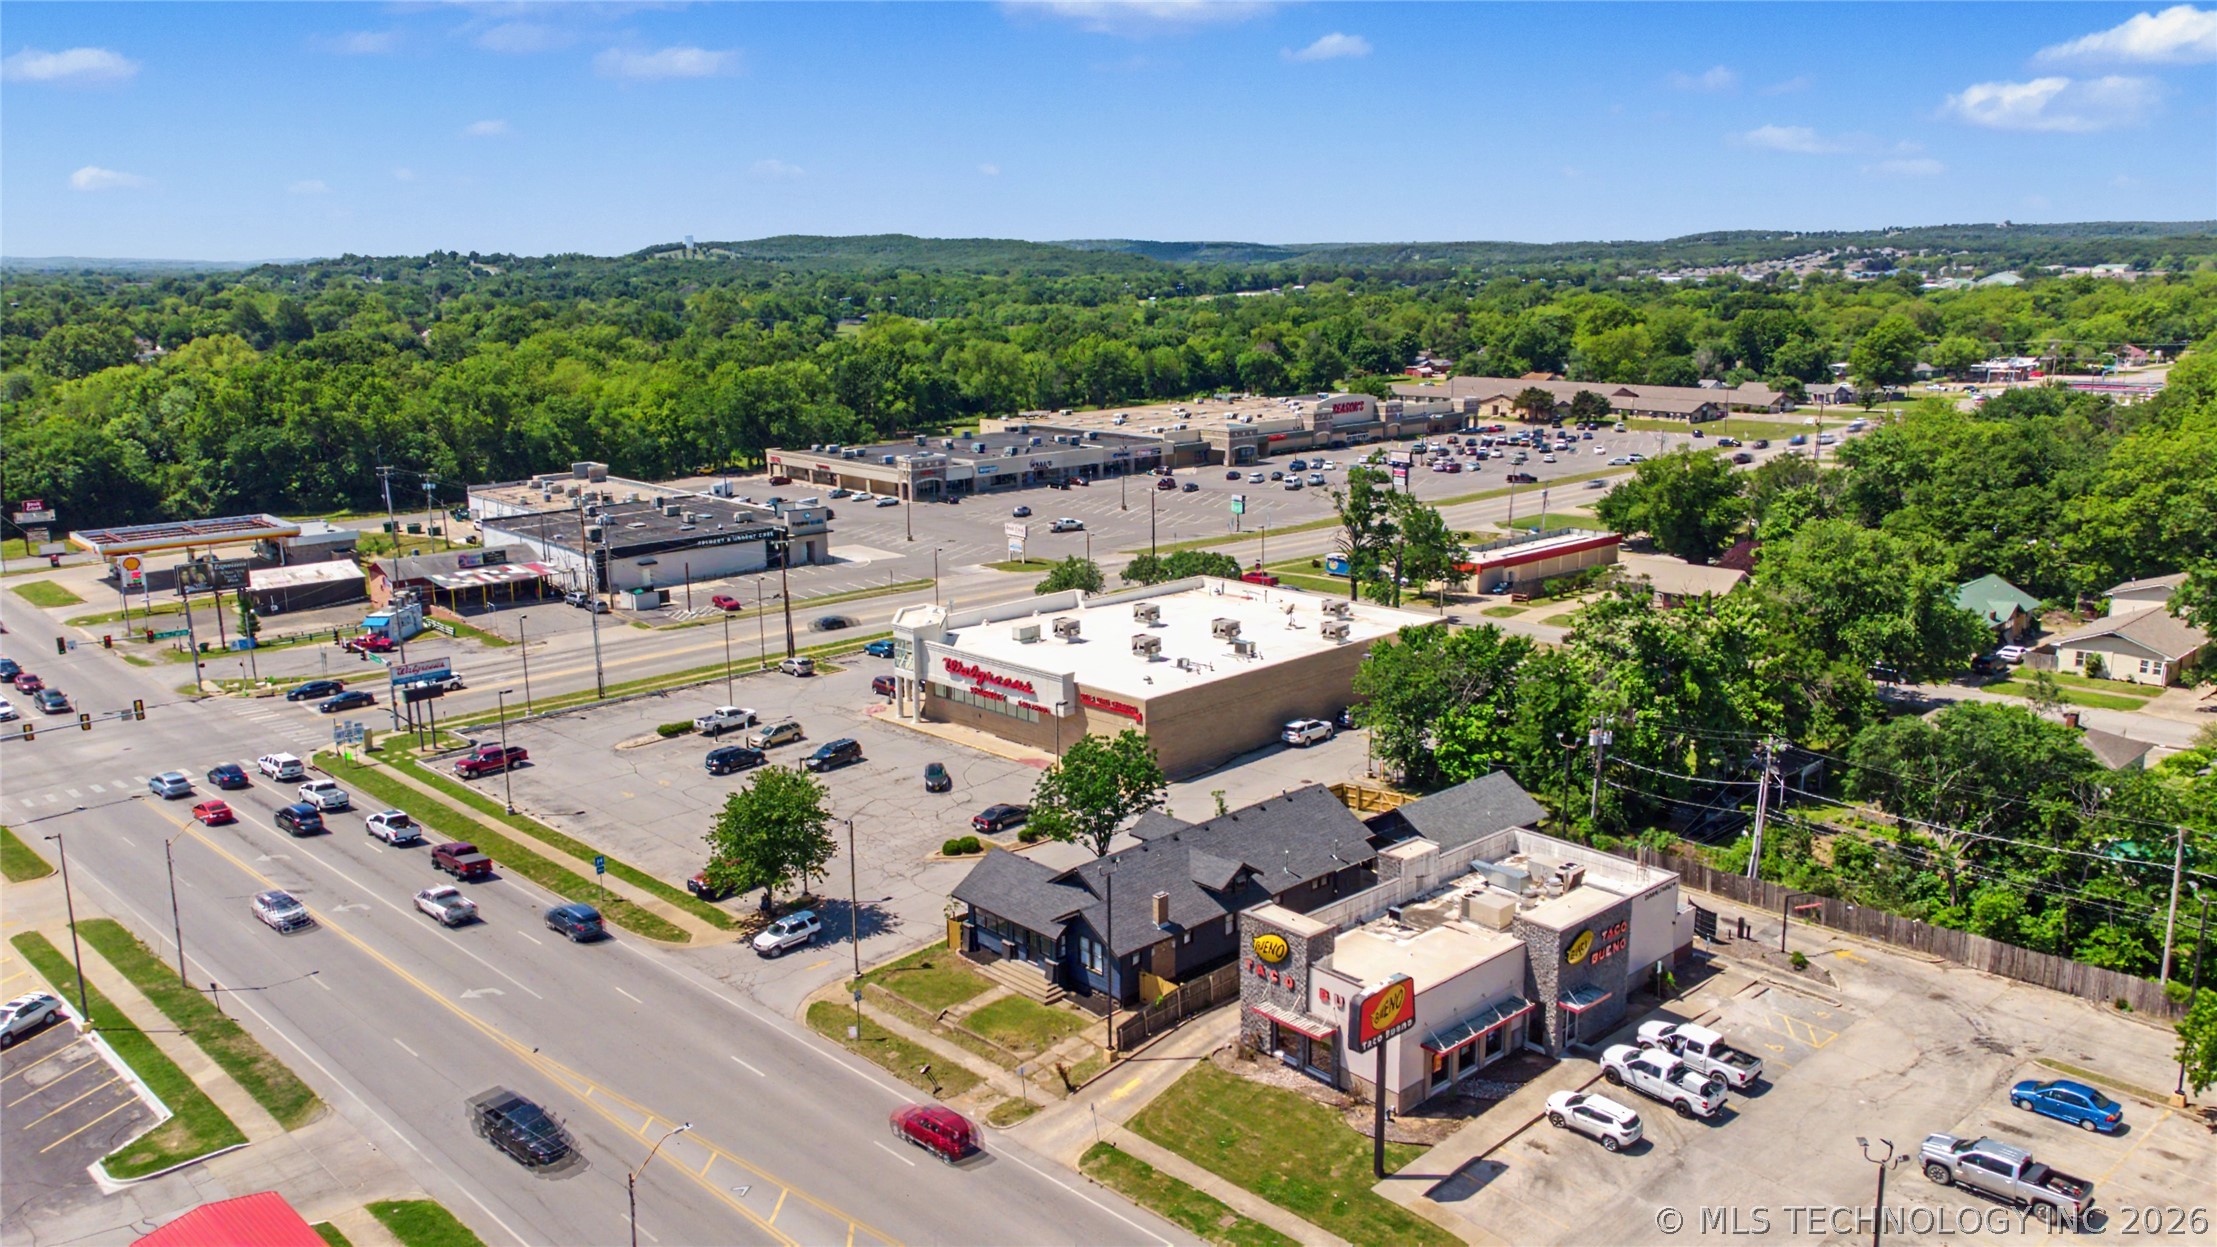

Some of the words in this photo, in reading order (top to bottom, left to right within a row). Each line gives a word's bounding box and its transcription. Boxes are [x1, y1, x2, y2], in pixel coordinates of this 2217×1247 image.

[396, 661, 445, 676] Walgreens
[942, 657, 1035, 695] Walgreens
[1602, 921, 1628, 941] TACO
[1254, 940, 1285, 958] BUENO
[1591, 938, 1627, 965] BUENO
[1244, 957, 1295, 989] TACO
[1373, 988, 1404, 1025] BUENO
[1361, 1034, 1383, 1051] TACO
